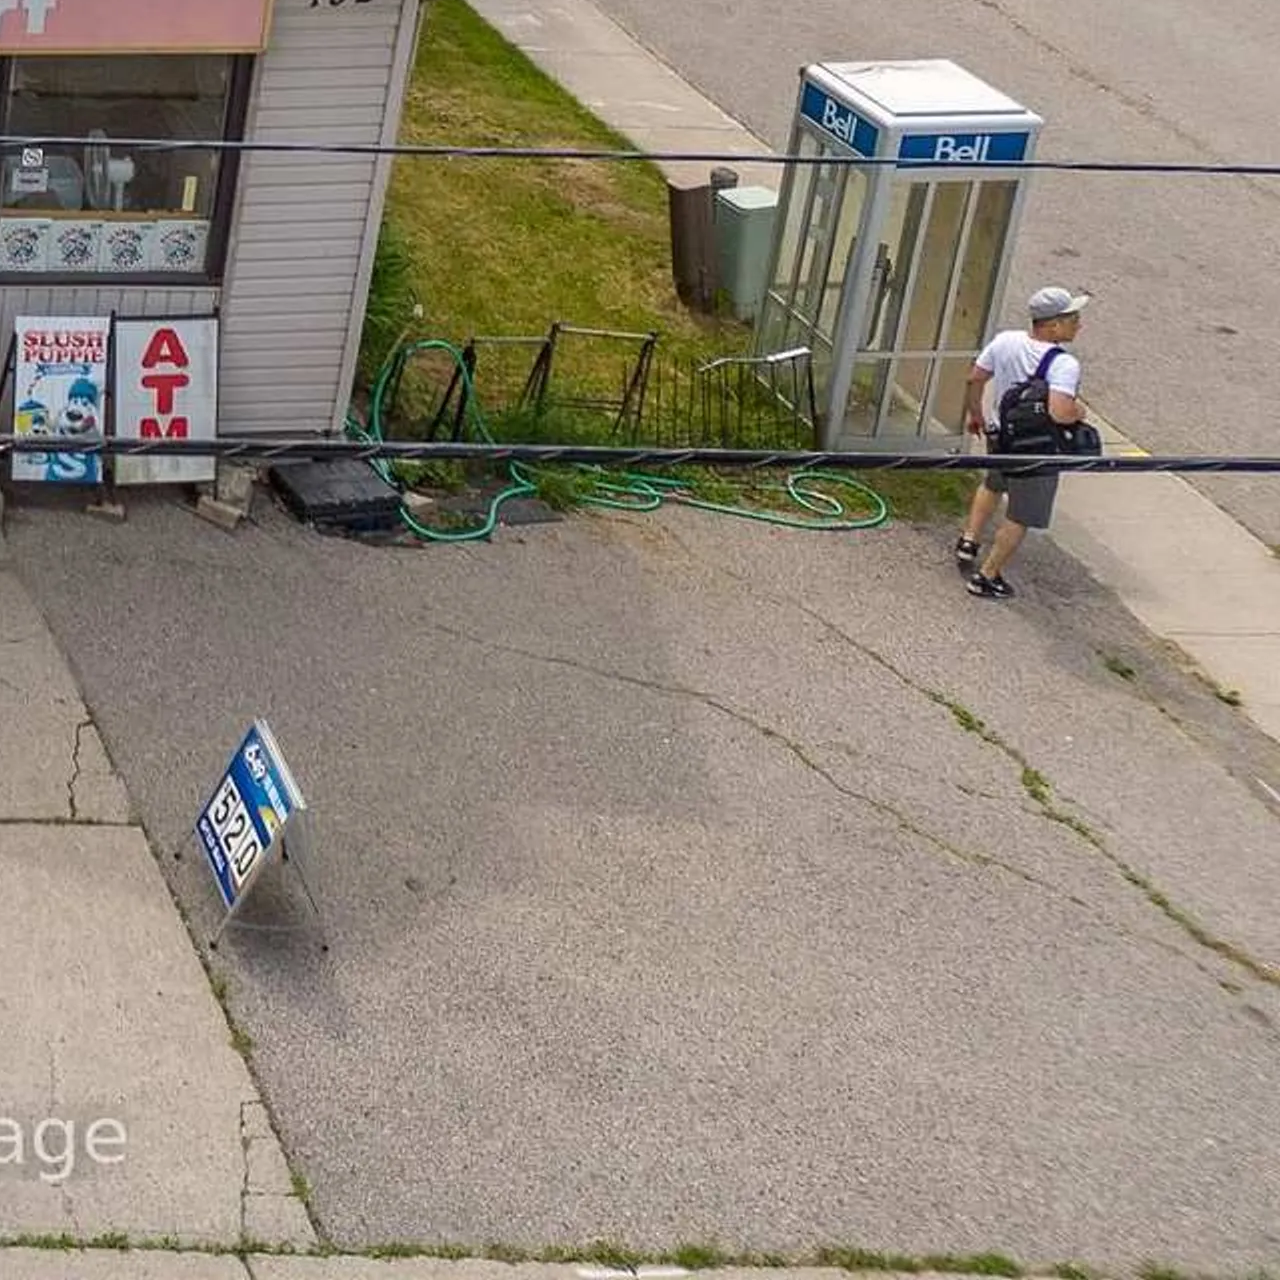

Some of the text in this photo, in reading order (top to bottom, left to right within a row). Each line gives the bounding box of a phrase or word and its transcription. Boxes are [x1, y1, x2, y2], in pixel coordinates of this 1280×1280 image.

[823, 98, 858, 144] Bell
[934, 135, 992, 162] Bell
[24, 331, 104, 348] SLUSH
[24, 348, 105, 363] PUPPIE
